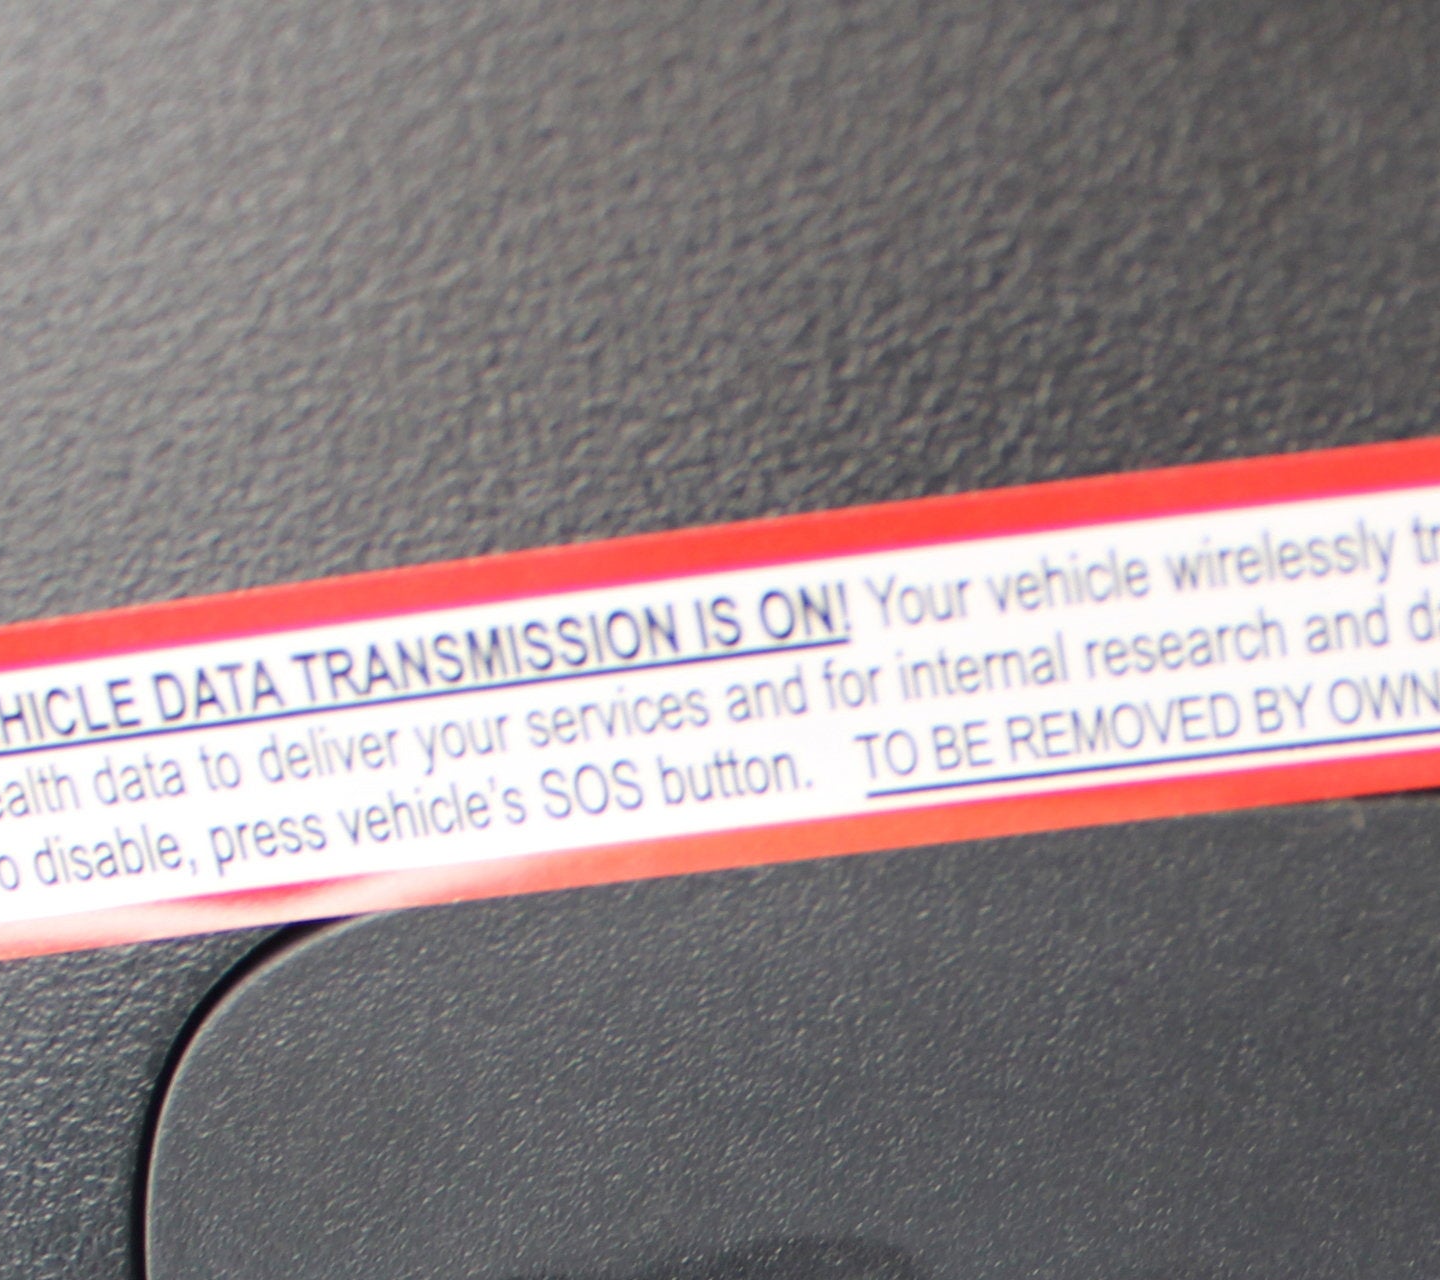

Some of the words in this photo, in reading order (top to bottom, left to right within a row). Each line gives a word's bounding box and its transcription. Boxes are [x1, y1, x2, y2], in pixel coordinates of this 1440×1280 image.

[90, 745, 187, 808] data
[196, 740, 242, 792] to
[256, 718, 401, 784] deliver
[411, 704, 510, 764] your
[527, 687, 710, 751] services
[726, 663, 811, 724] and
[825, 661, 880, 712] for
[897, 630, 1070, 696] internal
[1085, 608, 1287, 676] research
[1304, 594, 1389, 654] and
[152, 659, 285, 722] DATA
[291, 608, 680, 702] TRANSMISSION
[693, 595, 743, 648] IS
[757, 581, 850, 640] ON!
[866, 574, 968, 632] Your
[984, 548, 1152, 615] vehicle
[1163, 519, 1397, 594] wirelessly
[32, 821, 198, 888] disable,
[206, 807, 328, 877] press
[337, 775, 527, 848] vehicle's
[541, 761, 645, 820] SOS
[659, 740, 813, 807] button.
[854, 728, 920, 782] TO
[932, 718, 993, 773] BE
[1007, 689, 1243, 764] REMOVED
[1254, 680, 1319, 737] BY
